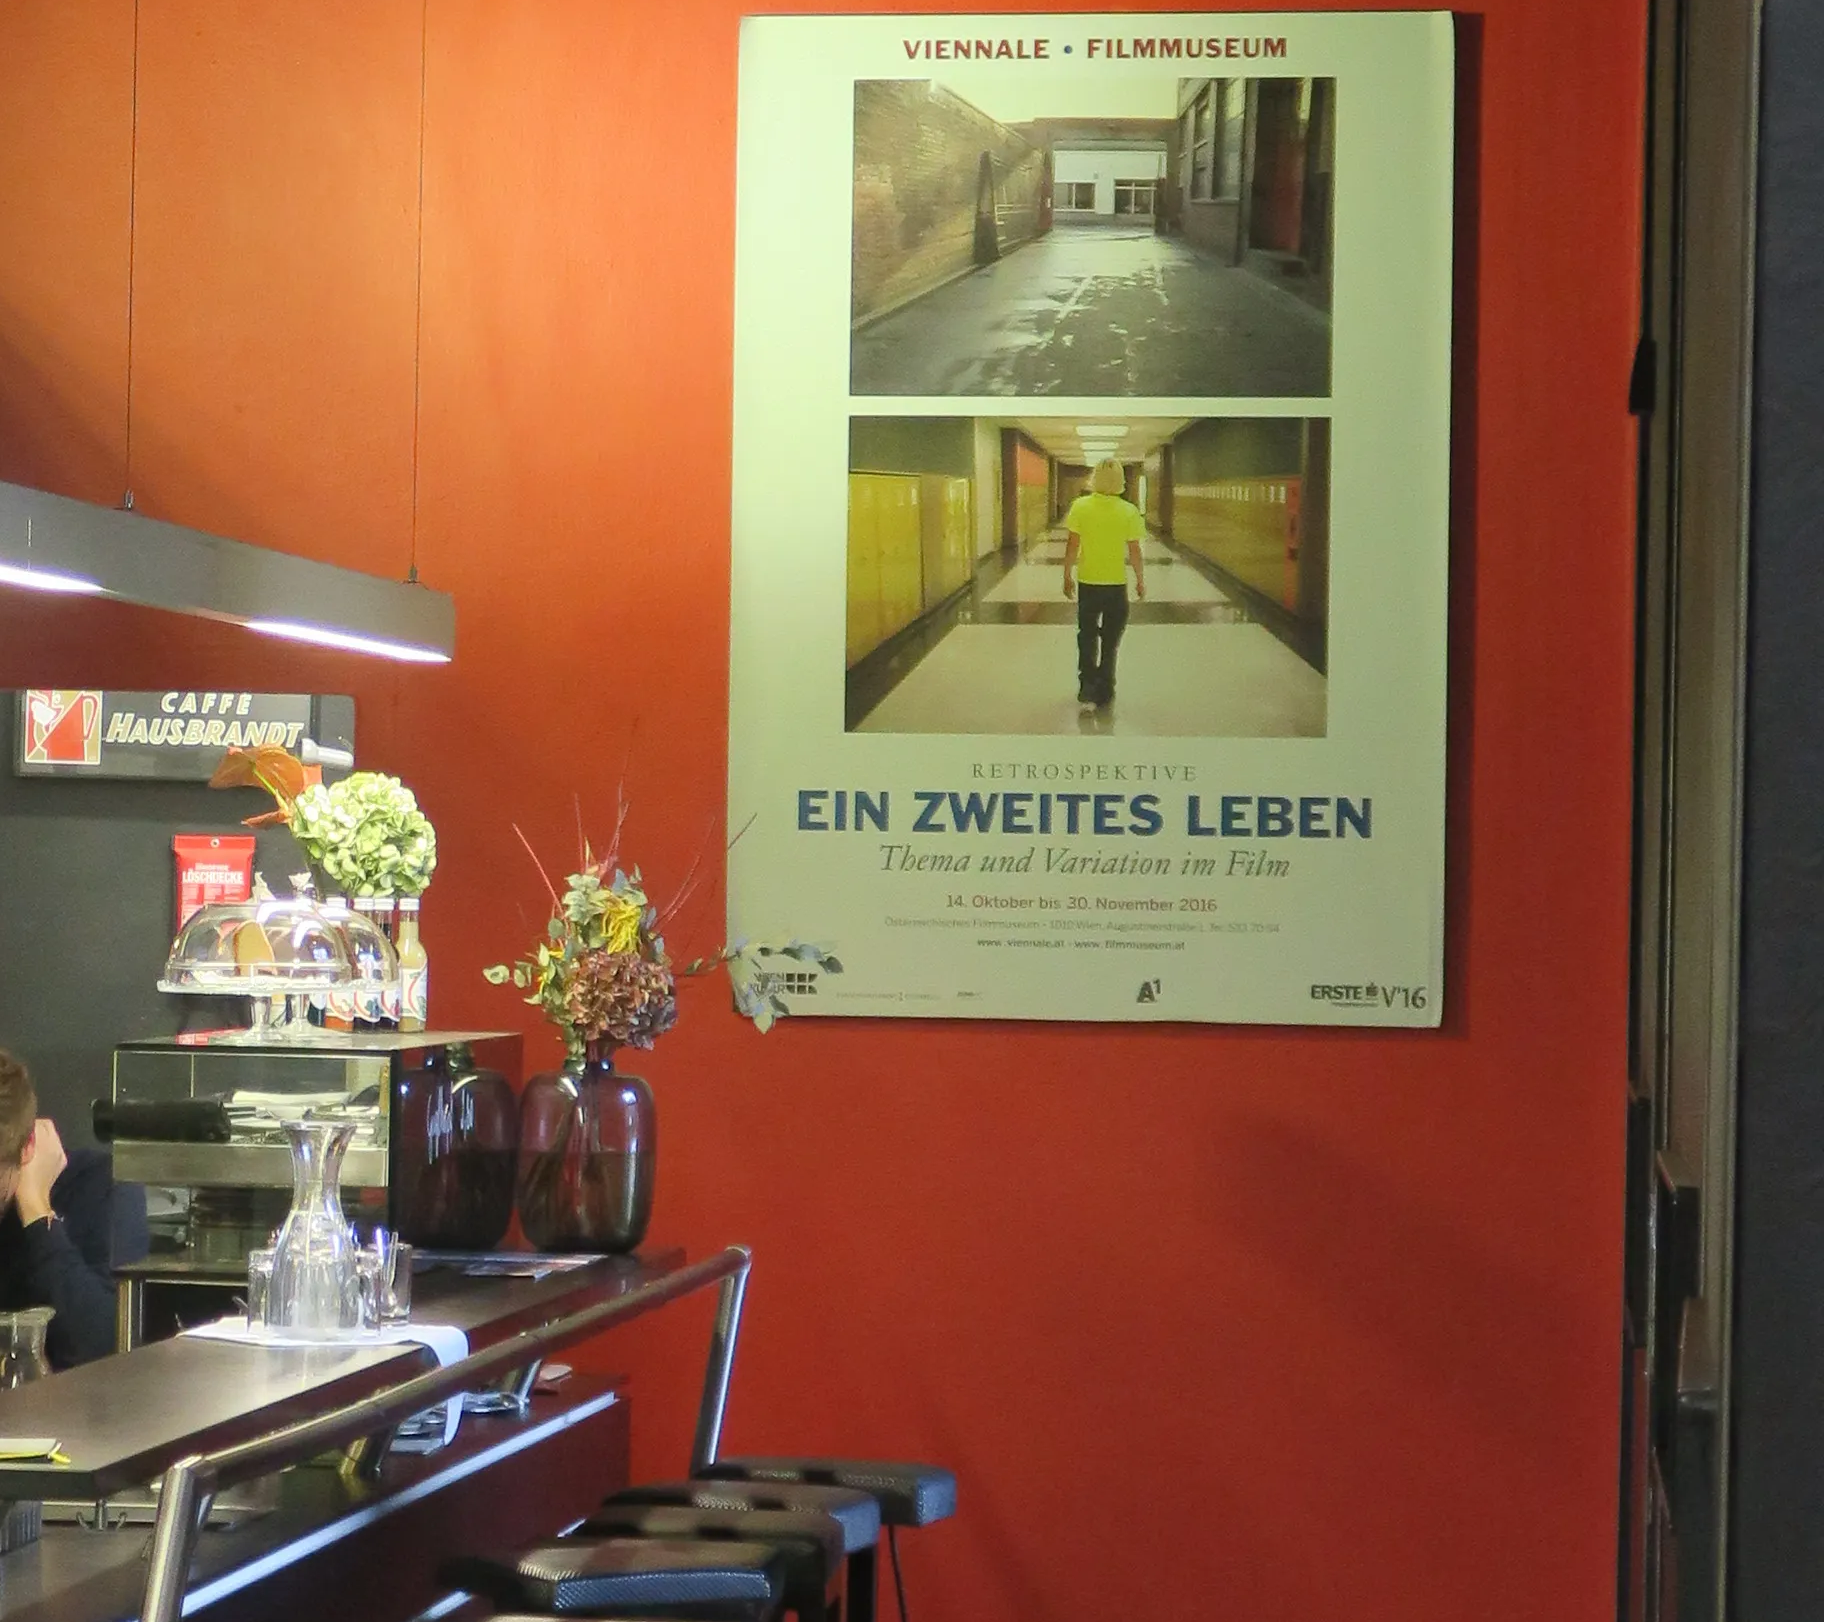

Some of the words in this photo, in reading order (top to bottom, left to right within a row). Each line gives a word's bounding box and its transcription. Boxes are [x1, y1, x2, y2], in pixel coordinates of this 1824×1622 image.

[903, 38, 1051, 60] VIENNALE
[1086, 37, 1288, 59] FILMMUSEUM
[106, 712, 305, 749] HAUSBRANDT
[971, 763, 1198, 782] RETROSPEKTIVE
[796, 790, 891, 833] EIN
[912, 792, 1165, 837] ZWEITES
[1186, 795, 1374, 840] LEBEN
[880, 844, 972, 874] Thema
[980, 846, 1036, 875] und
[1043, 846, 1171, 877] Variation
[1180, 849, 1218, 877] im
[1227, 849, 1291, 878] Film
[946, 895, 968, 909] 14.
[971, 895, 1035, 910] Oktober
[1039, 895, 1062, 910] bis
[1067, 896, 1092, 910] 30.
[1096, 896, 1175, 912] November
[1179, 897, 1218, 912] 2016
[1310, 984, 1363, 1001] ERSTE
